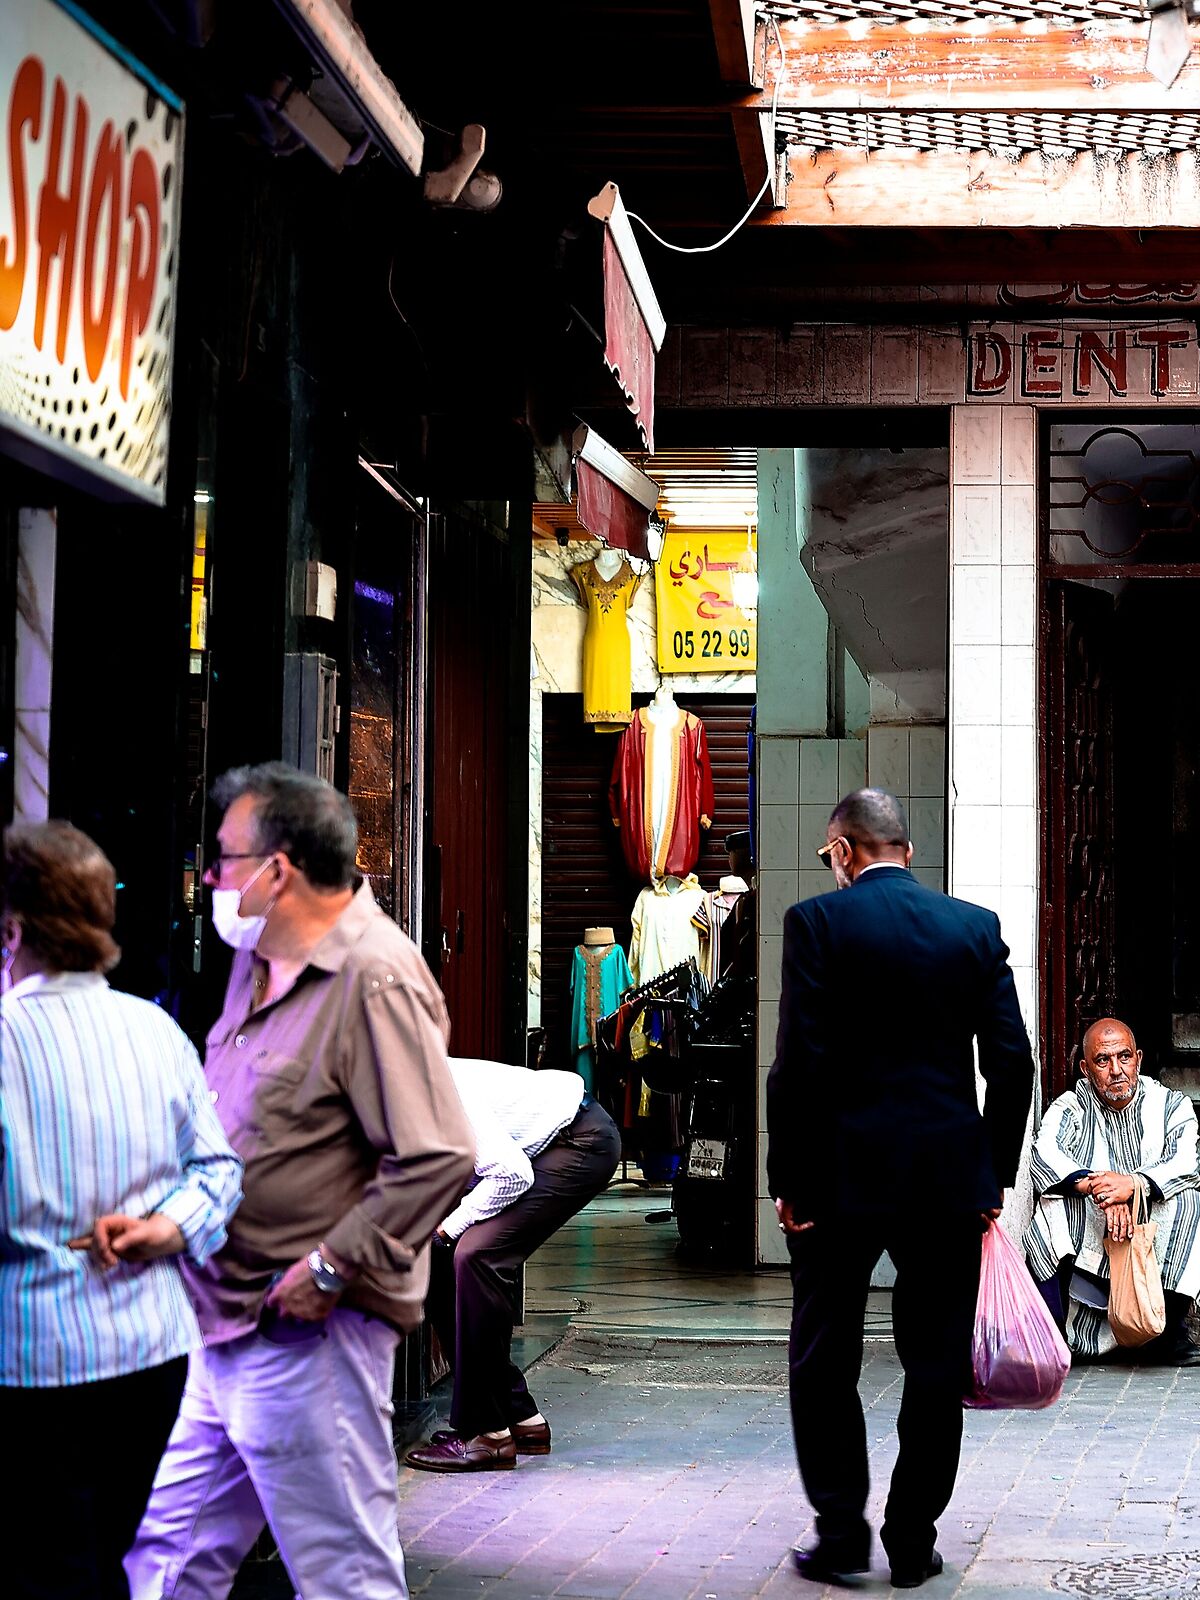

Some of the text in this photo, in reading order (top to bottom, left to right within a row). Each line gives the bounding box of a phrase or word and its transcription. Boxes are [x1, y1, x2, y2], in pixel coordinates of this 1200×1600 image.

[0, 54, 161, 403] SHOP
[673, 628, 750, 659] 05 22 99
